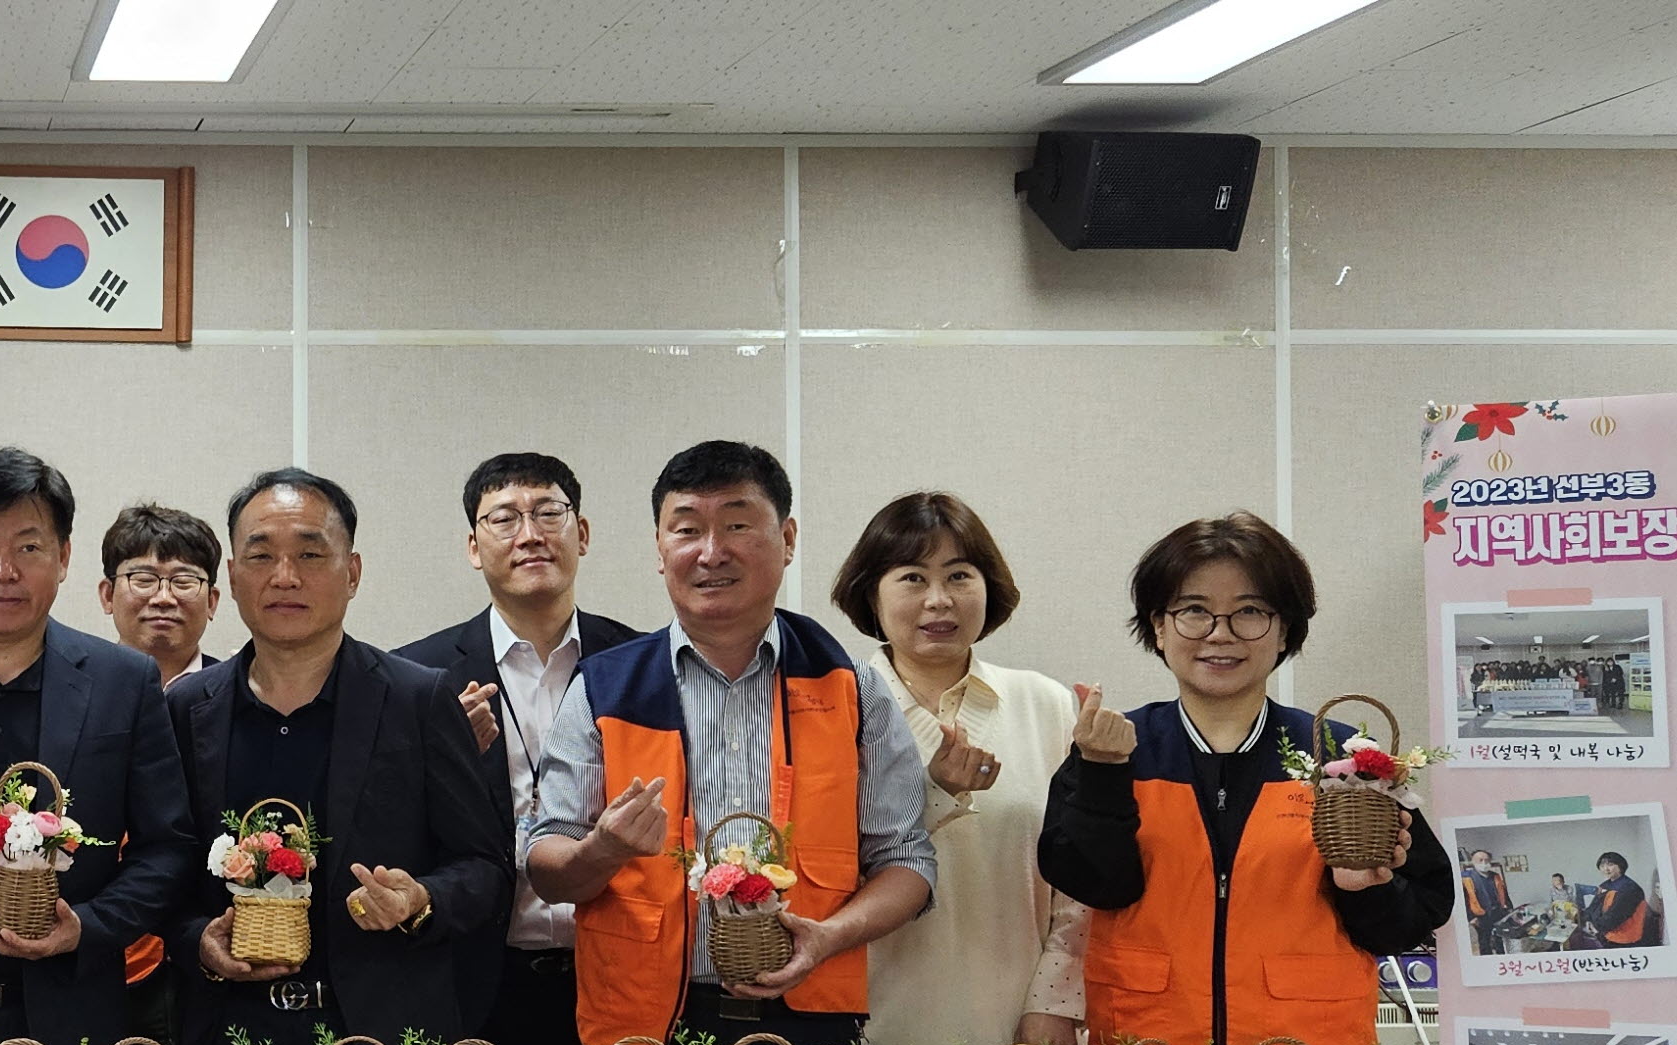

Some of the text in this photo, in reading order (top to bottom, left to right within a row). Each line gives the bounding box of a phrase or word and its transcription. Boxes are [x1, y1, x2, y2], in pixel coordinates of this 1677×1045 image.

[1451, 470, 1656, 506] 2023년 선부3동
[1452, 507, 1677, 567] 지역사회보장
[1570, 742, 1600, 761] 내복
[1606, 743, 1645, 761] 나눔)
